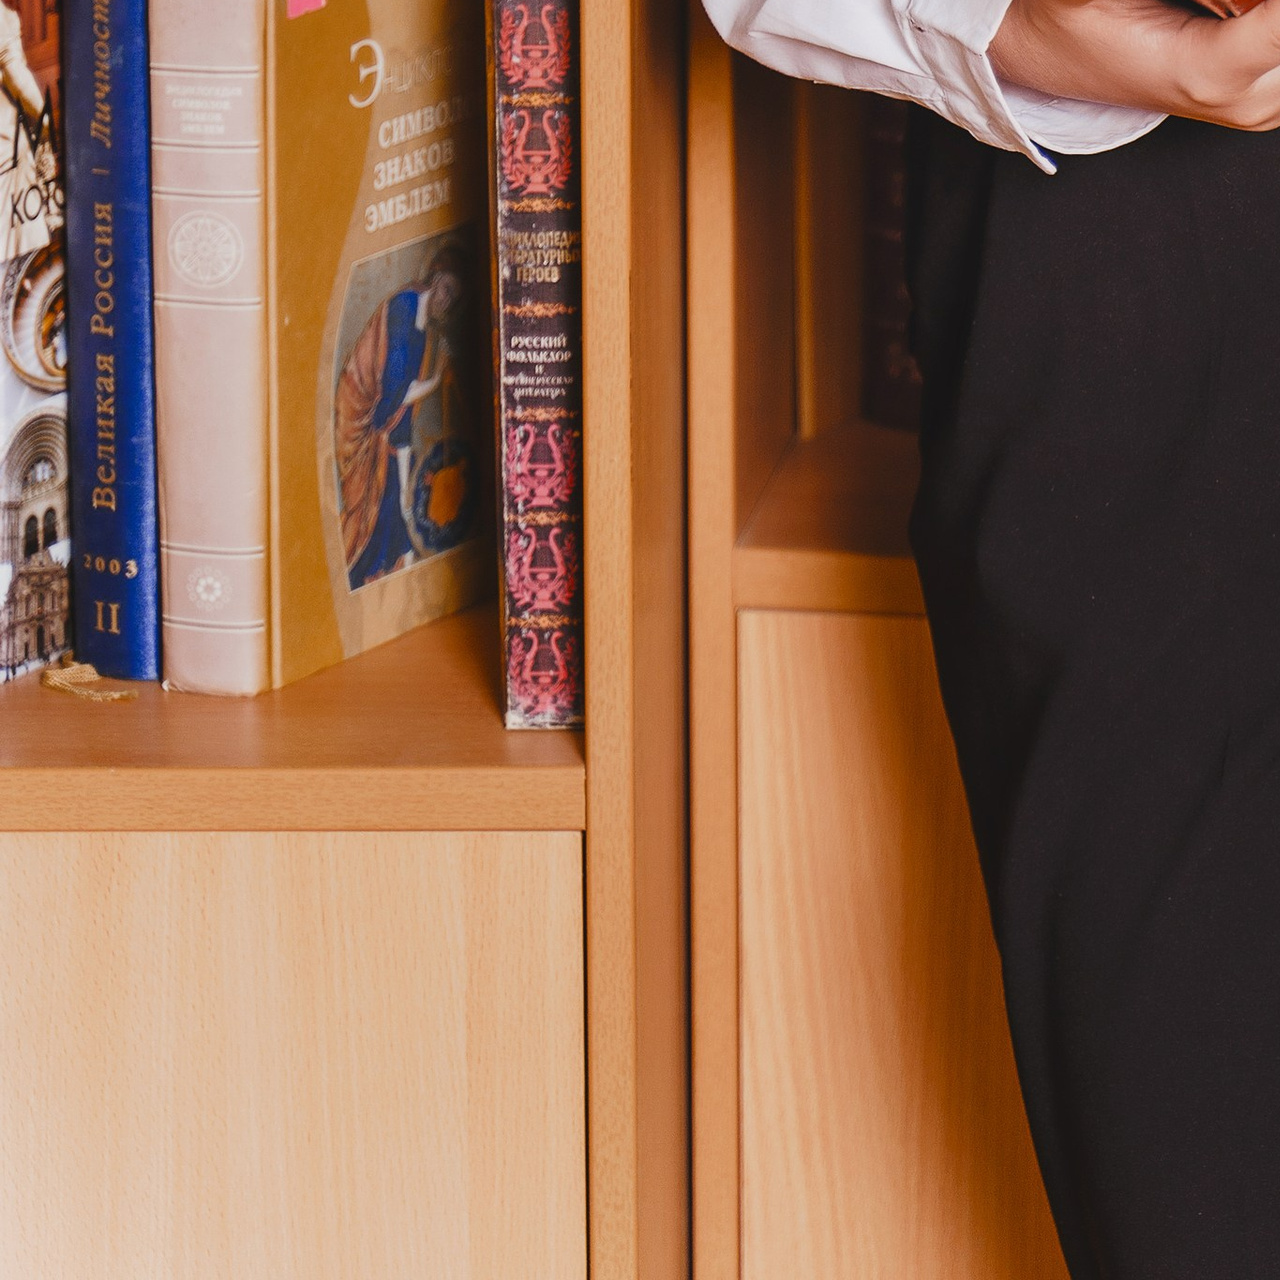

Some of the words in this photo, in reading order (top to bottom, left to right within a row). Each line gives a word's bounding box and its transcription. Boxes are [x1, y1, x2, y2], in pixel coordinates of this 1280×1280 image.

[89, 201, 116, 338] Россия
[516, 266, 561, 284] ГЕРОЕВ
[510, 332, 568, 349] РУССКИЙ
[506, 350, 572, 364] ФОЛЬКЛОР
[91, 352, 118, 513] Великая
[82, 552, 140, 580] 2003
